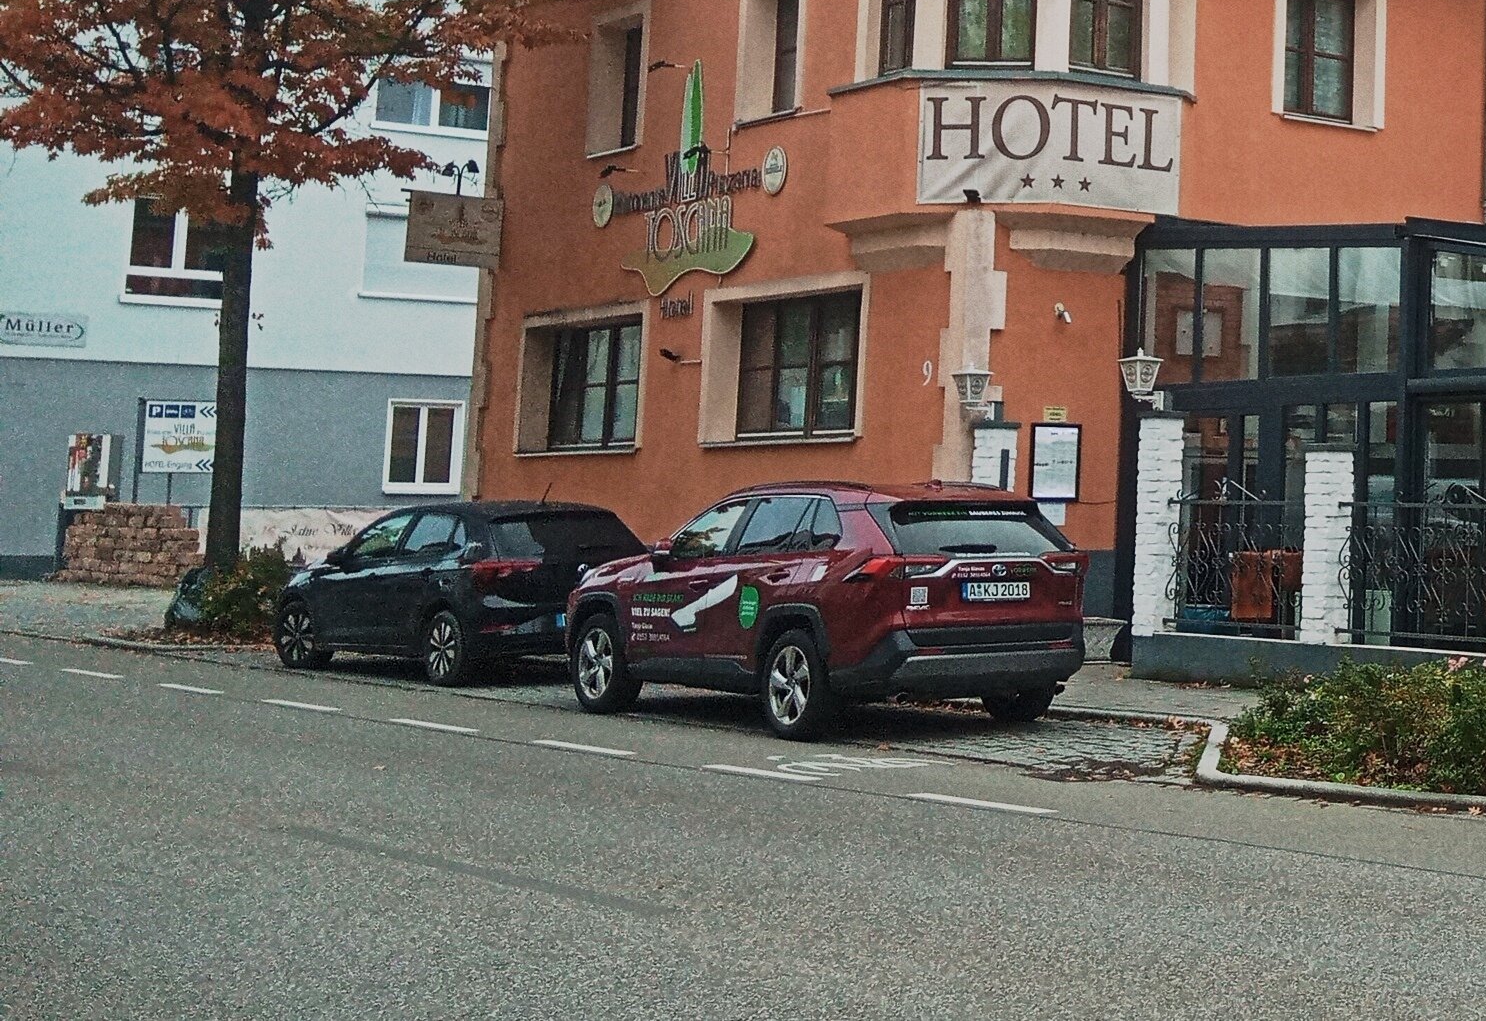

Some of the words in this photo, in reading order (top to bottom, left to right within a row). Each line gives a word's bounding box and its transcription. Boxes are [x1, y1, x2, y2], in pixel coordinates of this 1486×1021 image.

[926, 93, 1174, 173] HOTEL
[644, 195, 732, 262] TOSCANA
[5, 318, 75, 333] Müller
[922, 360, 933, 386] 9
[969, 584, 977, 597] A
[983, 584, 999, 597] KJ
[1000, 584, 1028, 597] 2018
